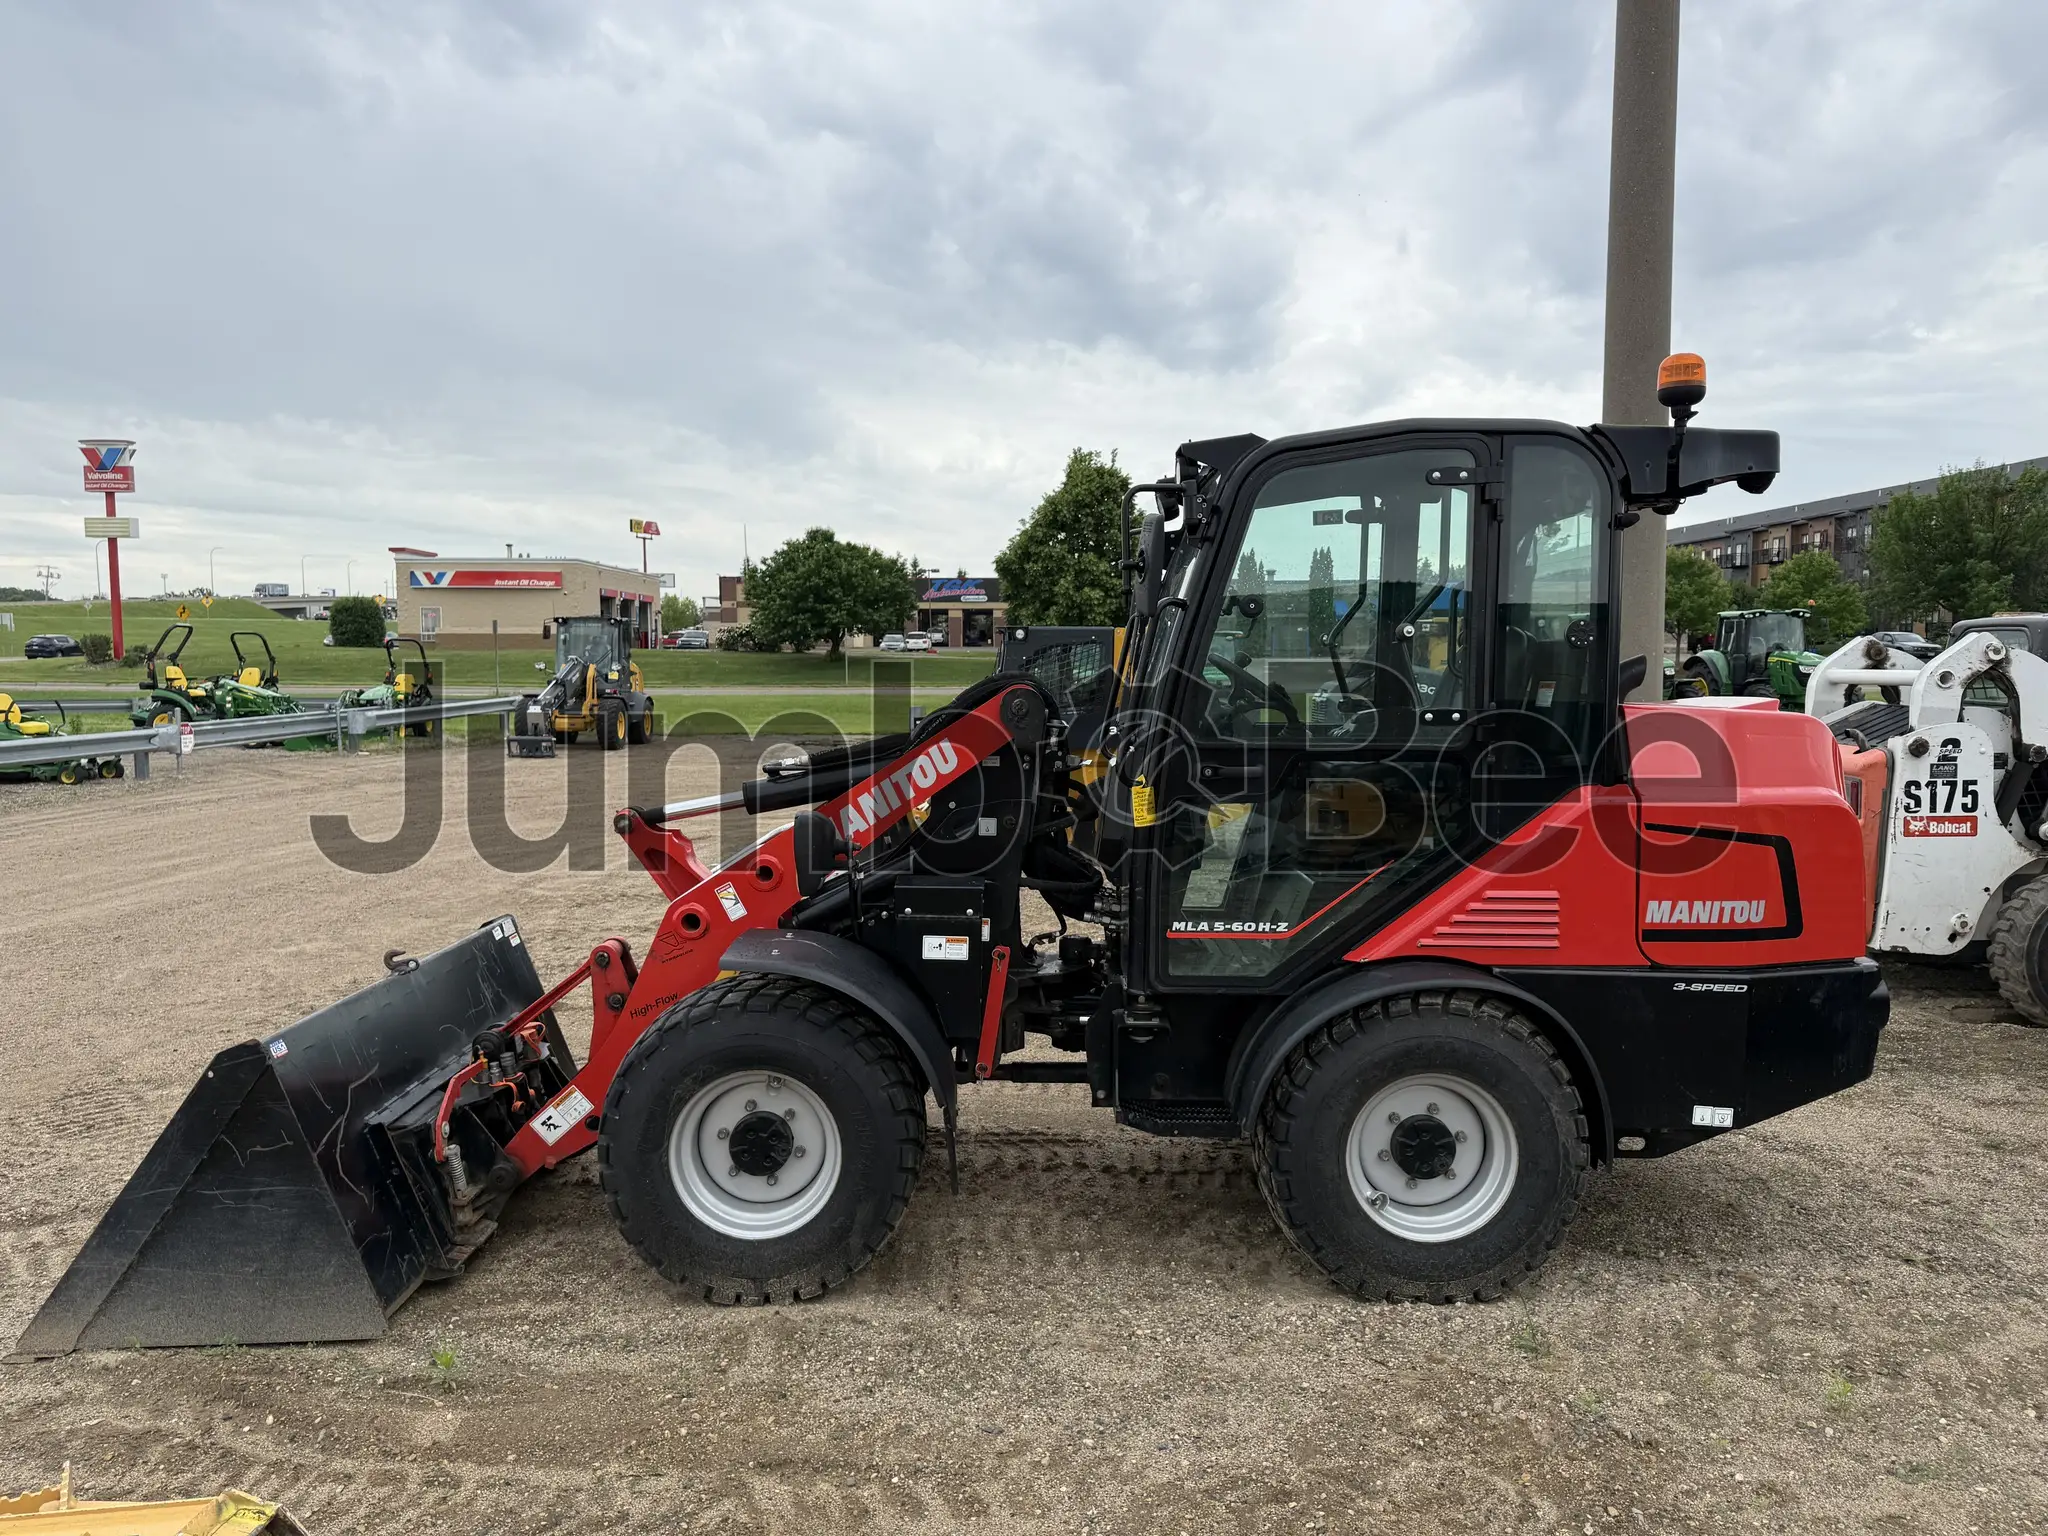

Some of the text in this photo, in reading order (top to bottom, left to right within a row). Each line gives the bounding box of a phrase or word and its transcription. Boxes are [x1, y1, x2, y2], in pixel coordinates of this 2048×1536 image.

[87, 472, 123, 480] Valvoline
[1937, 737, 1962, 762] 2
[829, 737, 959, 842] ANITOU
[1904, 780, 1979, 813] S175
[1929, 821, 1971, 834] Bobcat
[1645, 900, 1766, 924] MANITOU
[1172, 921, 1209, 931] MLA
[1673, 982, 1748, 993] 3-SPEED
[630, 992, 679, 1019] High-Flow
[272, 1043, 286, 1054] USA
